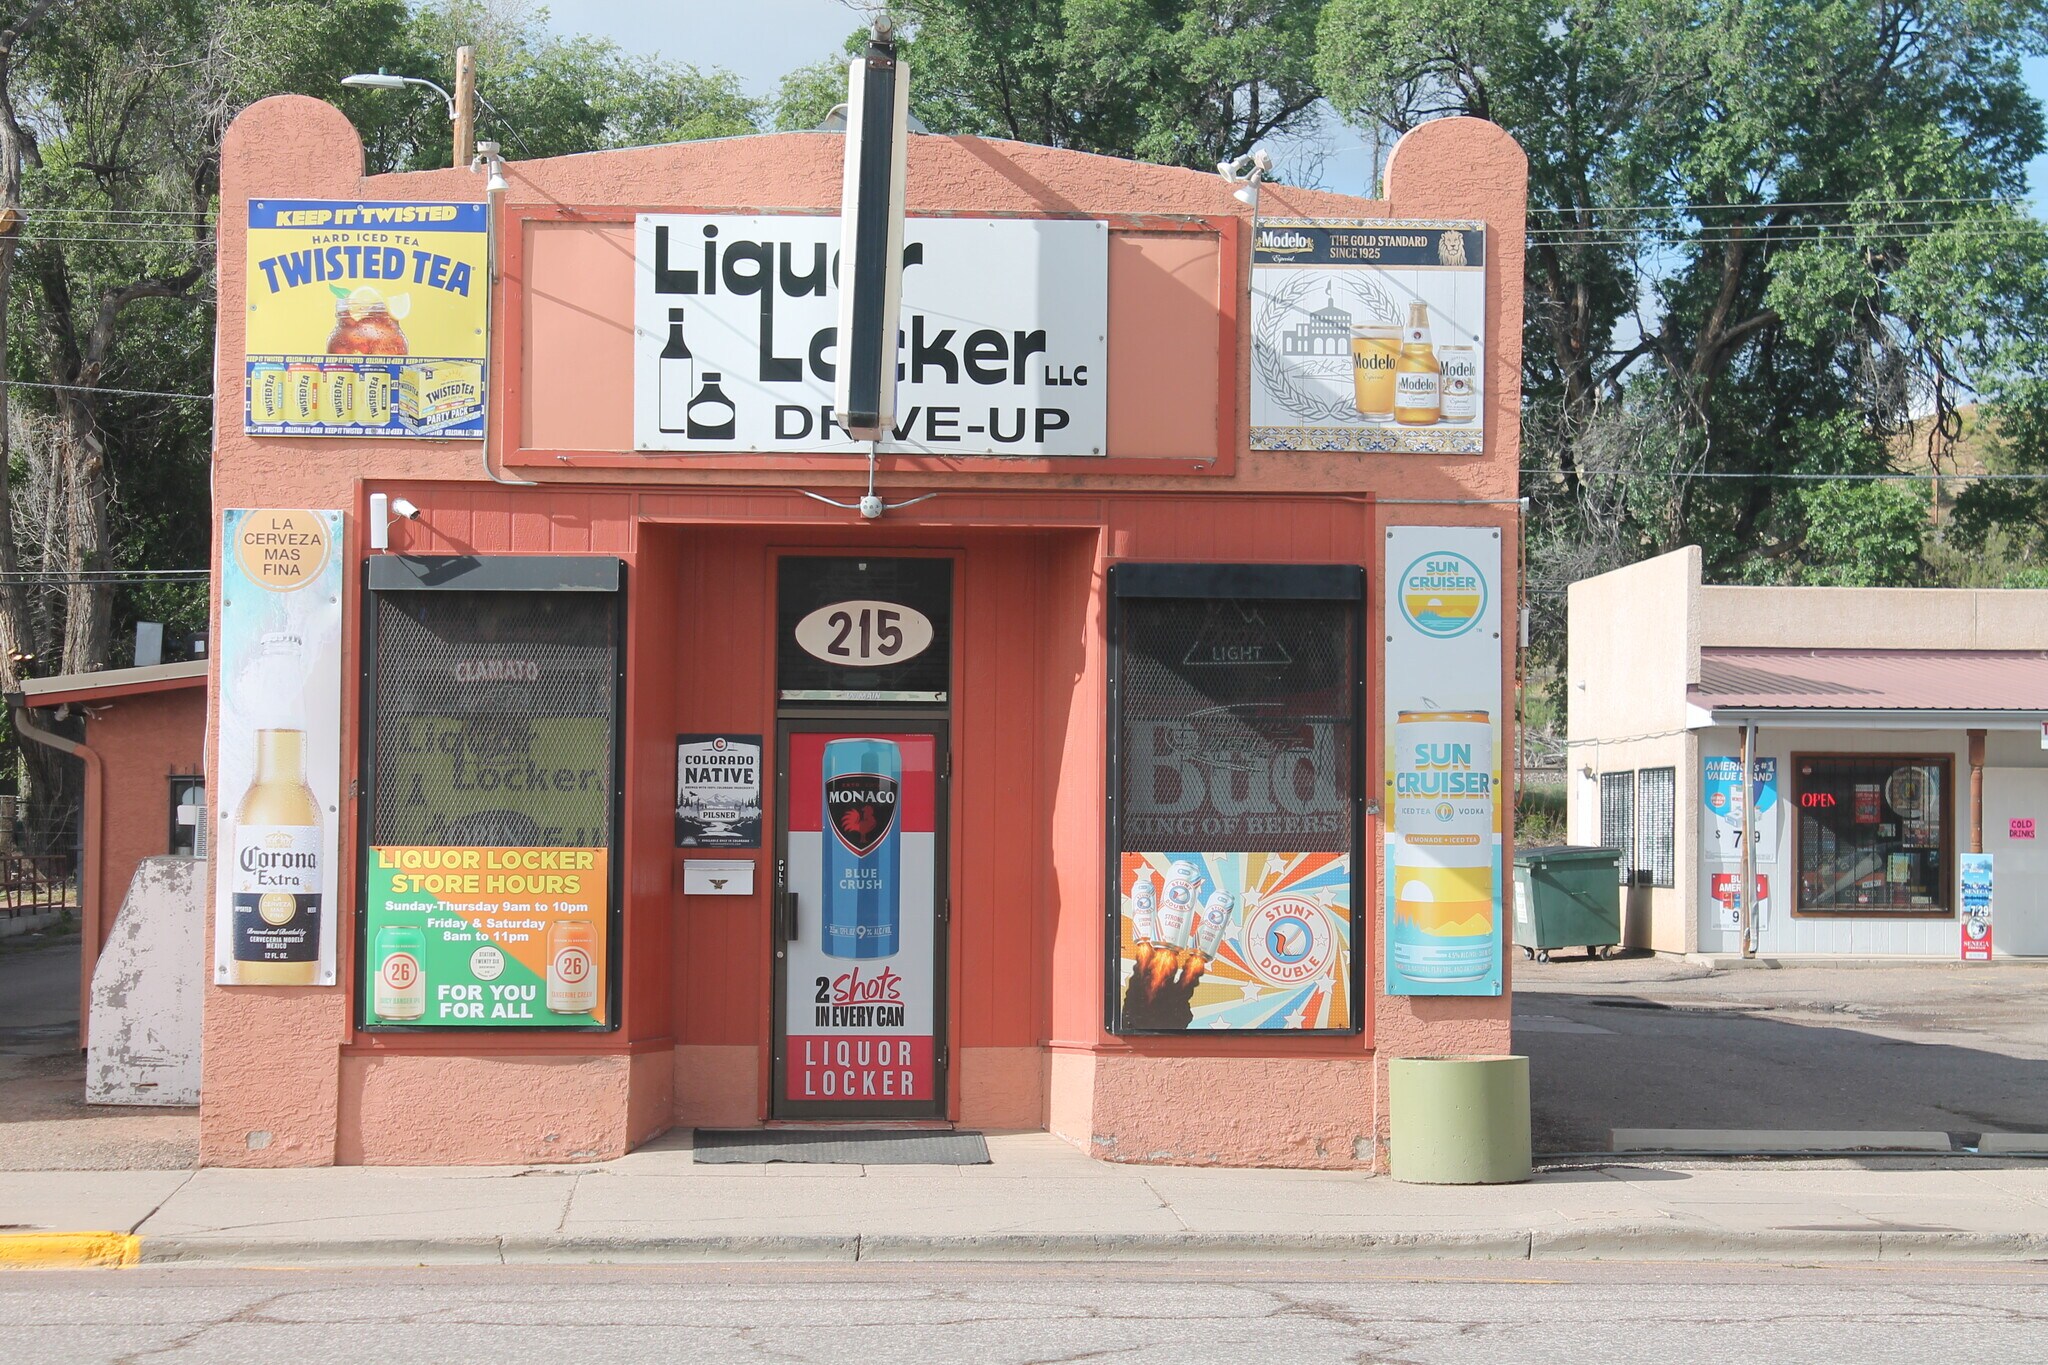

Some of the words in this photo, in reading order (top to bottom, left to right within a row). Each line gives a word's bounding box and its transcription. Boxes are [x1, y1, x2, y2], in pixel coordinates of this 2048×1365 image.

[276, 209, 332, 227] KEEP
[334, 208, 357, 224] IT
[359, 206, 458, 224] TWISTED
[312, 233, 350, 245] HARD
[356, 233, 388, 243] ICED
[395, 235, 420, 247] TEA
[1262, 231, 1306, 248] Modelo
[1330, 235, 1349, 246] THE
[1351, 236, 1376, 247] GOLD
[1378, 236, 1428, 247] STANDARD
[1330, 248, 1357, 259] SINCE
[1359, 248, 1380, 259] 1925
[258, 245, 406, 294] TWISTED
[412, 250, 473, 298] TEA
[655, 224, 923, 312] Liqur
[760, 314, 1046, 385] Loker
[1045, 366, 1087, 386] LLC
[1354, 352, 1396, 370] Modelo
[1441, 360, 1475, 377] Modelo
[265, 374, 276, 388] TEA
[299, 375, 310, 388] TEA
[334, 376, 345, 390] TEA
[369, 376, 380, 390] TEA
[1401, 377, 1434, 390] Modelo
[426, 385, 460, 404] TWISTED
[461, 383, 474, 395] TEA
[264, 388, 275, 417] TWISTED
[299, 388, 310, 418] TWISTED
[334, 390, 345, 418] TWISTED
[369, 390, 380, 418] TWISTED
[427, 409, 452, 425] PARTY
[452, 407, 469, 419] PACK
[775, 404, 1070, 443] DRVE-UP
[271, 518, 294, 531] LA
[244, 533, 322, 546] CERVEZA
[264, 549, 301, 561] MAS
[263, 564, 301, 576] FINA
[1426, 562, 1459, 574] SUN
[1409, 576, 1477, 589] CRUISER
[828, 609, 904, 659] 215
[1212, 646, 1262, 661] LIGHT
[455, 659, 539, 682] CLAMATO
[686, 756, 754, 765] COLORADO
[1415, 744, 1471, 766] SUN
[1127, 721, 1346, 816] Bud
[1761, 761, 1775, 772] #1
[685, 768, 754, 784] NATIVE
[1397, 772, 1490, 796] CRUISER
[1707, 772, 1737, 781] VALUE
[829, 790, 895, 804] MONACO
[1802, 792, 1837, 807] OPEN
[2012, 820, 2032, 828] COLD
[1716, 830, 1721, 839] $
[2010, 830, 2035, 838] DRINKS
[240, 846, 317, 875] Corona
[378, 850, 481, 870] LIQUOR
[487, 850, 594, 870] LOCKER
[258, 870, 300, 886] Extra
[846, 868, 878, 878] BLUE
[391, 874, 480, 894] STORE
[486, 874, 581, 894] HOURS
[840, 880, 883, 890] CRUSH
[1172, 880, 1193, 891] STUNT
[385, 901, 499, 914] Sunday-Thursday
[502, 902, 531, 913] 9am
[535, 902, 549, 913] to
[552, 902, 589, 914] 10pm
[1165, 900, 1191, 911] DOUBLE
[1266, 904, 1314, 922] STUNT
[427, 918, 468, 930] Friday
[472, 918, 482, 929] &
[486, 918, 546, 931] Saturday
[1165, 914, 1184, 924] STRONG
[1165, 920, 1181, 929] LAGER
[1733, 910, 1740, 923] 9
[443, 932, 471, 942] 8am
[476, 932, 490, 942] to
[493, 932, 530, 943] 11pm
[392, 964, 410, 981] 26
[564, 958, 582, 975] 26
[1260, 956, 1320, 978] DOUBLE
[438, 984, 483, 1001] FOR
[489, 985, 537, 1001] YOU
[815, 977, 830, 1004] 2
[440, 1002, 484, 1019] FOR
[490, 1002, 534, 1019] ALL
[815, 1006, 830, 1027] IN
[833, 1006, 874, 1027] EVERY
[876, 1006, 905, 1027] CAN
[805, 1040, 912, 1068] LIQUOR
[805, 1070, 914, 1096] LOCKER
